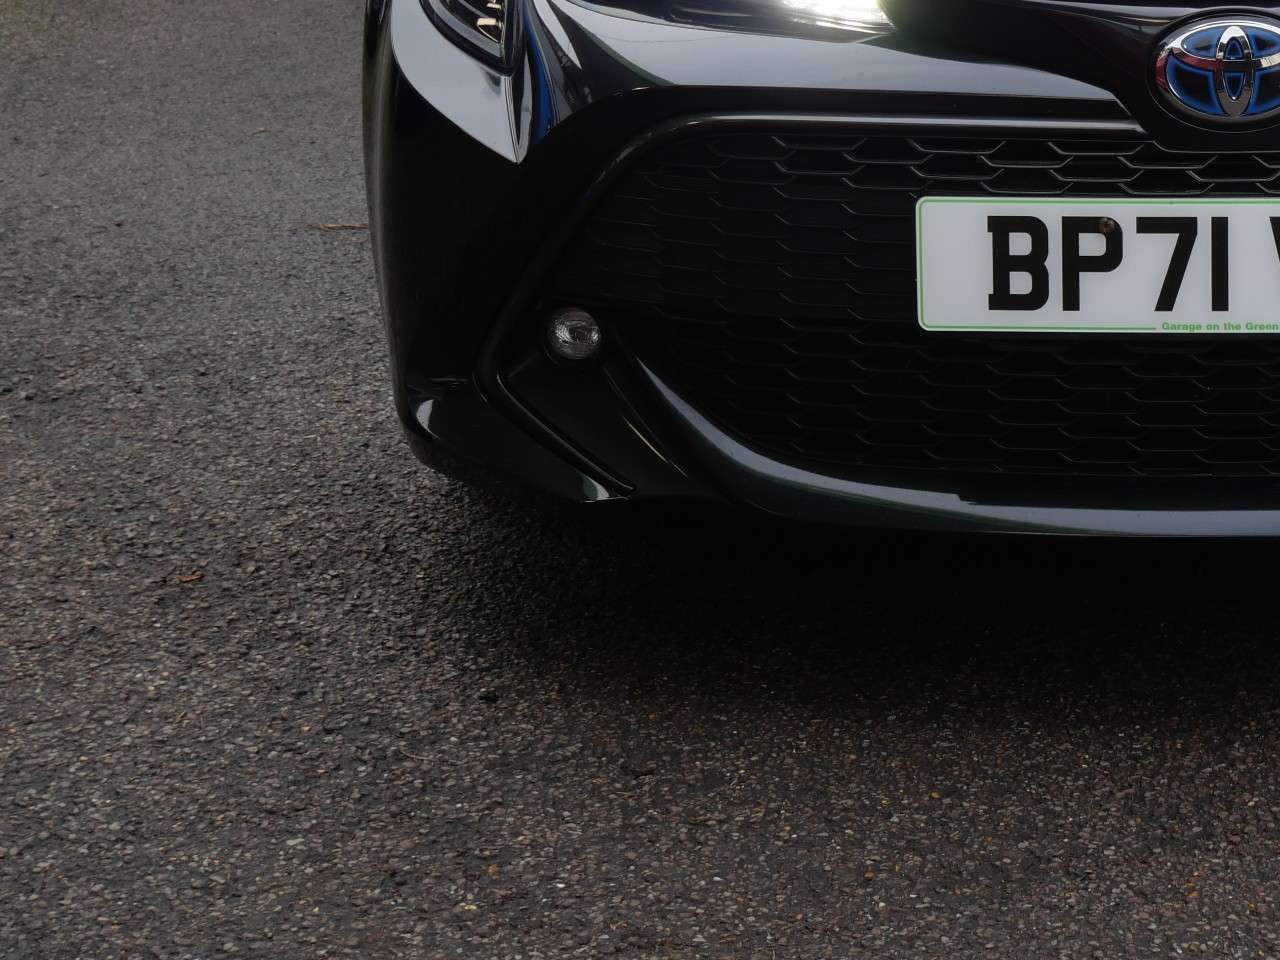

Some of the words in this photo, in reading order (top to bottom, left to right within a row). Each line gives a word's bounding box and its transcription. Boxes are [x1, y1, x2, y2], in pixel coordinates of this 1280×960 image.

[986, 214, 1230, 312] BP71
[1161, 321, 1202, 333] Garage
[1206, 323, 1221, 331] on
[1223, 321, 1242, 331] the
[1245, 321, 1280, 331] Green
